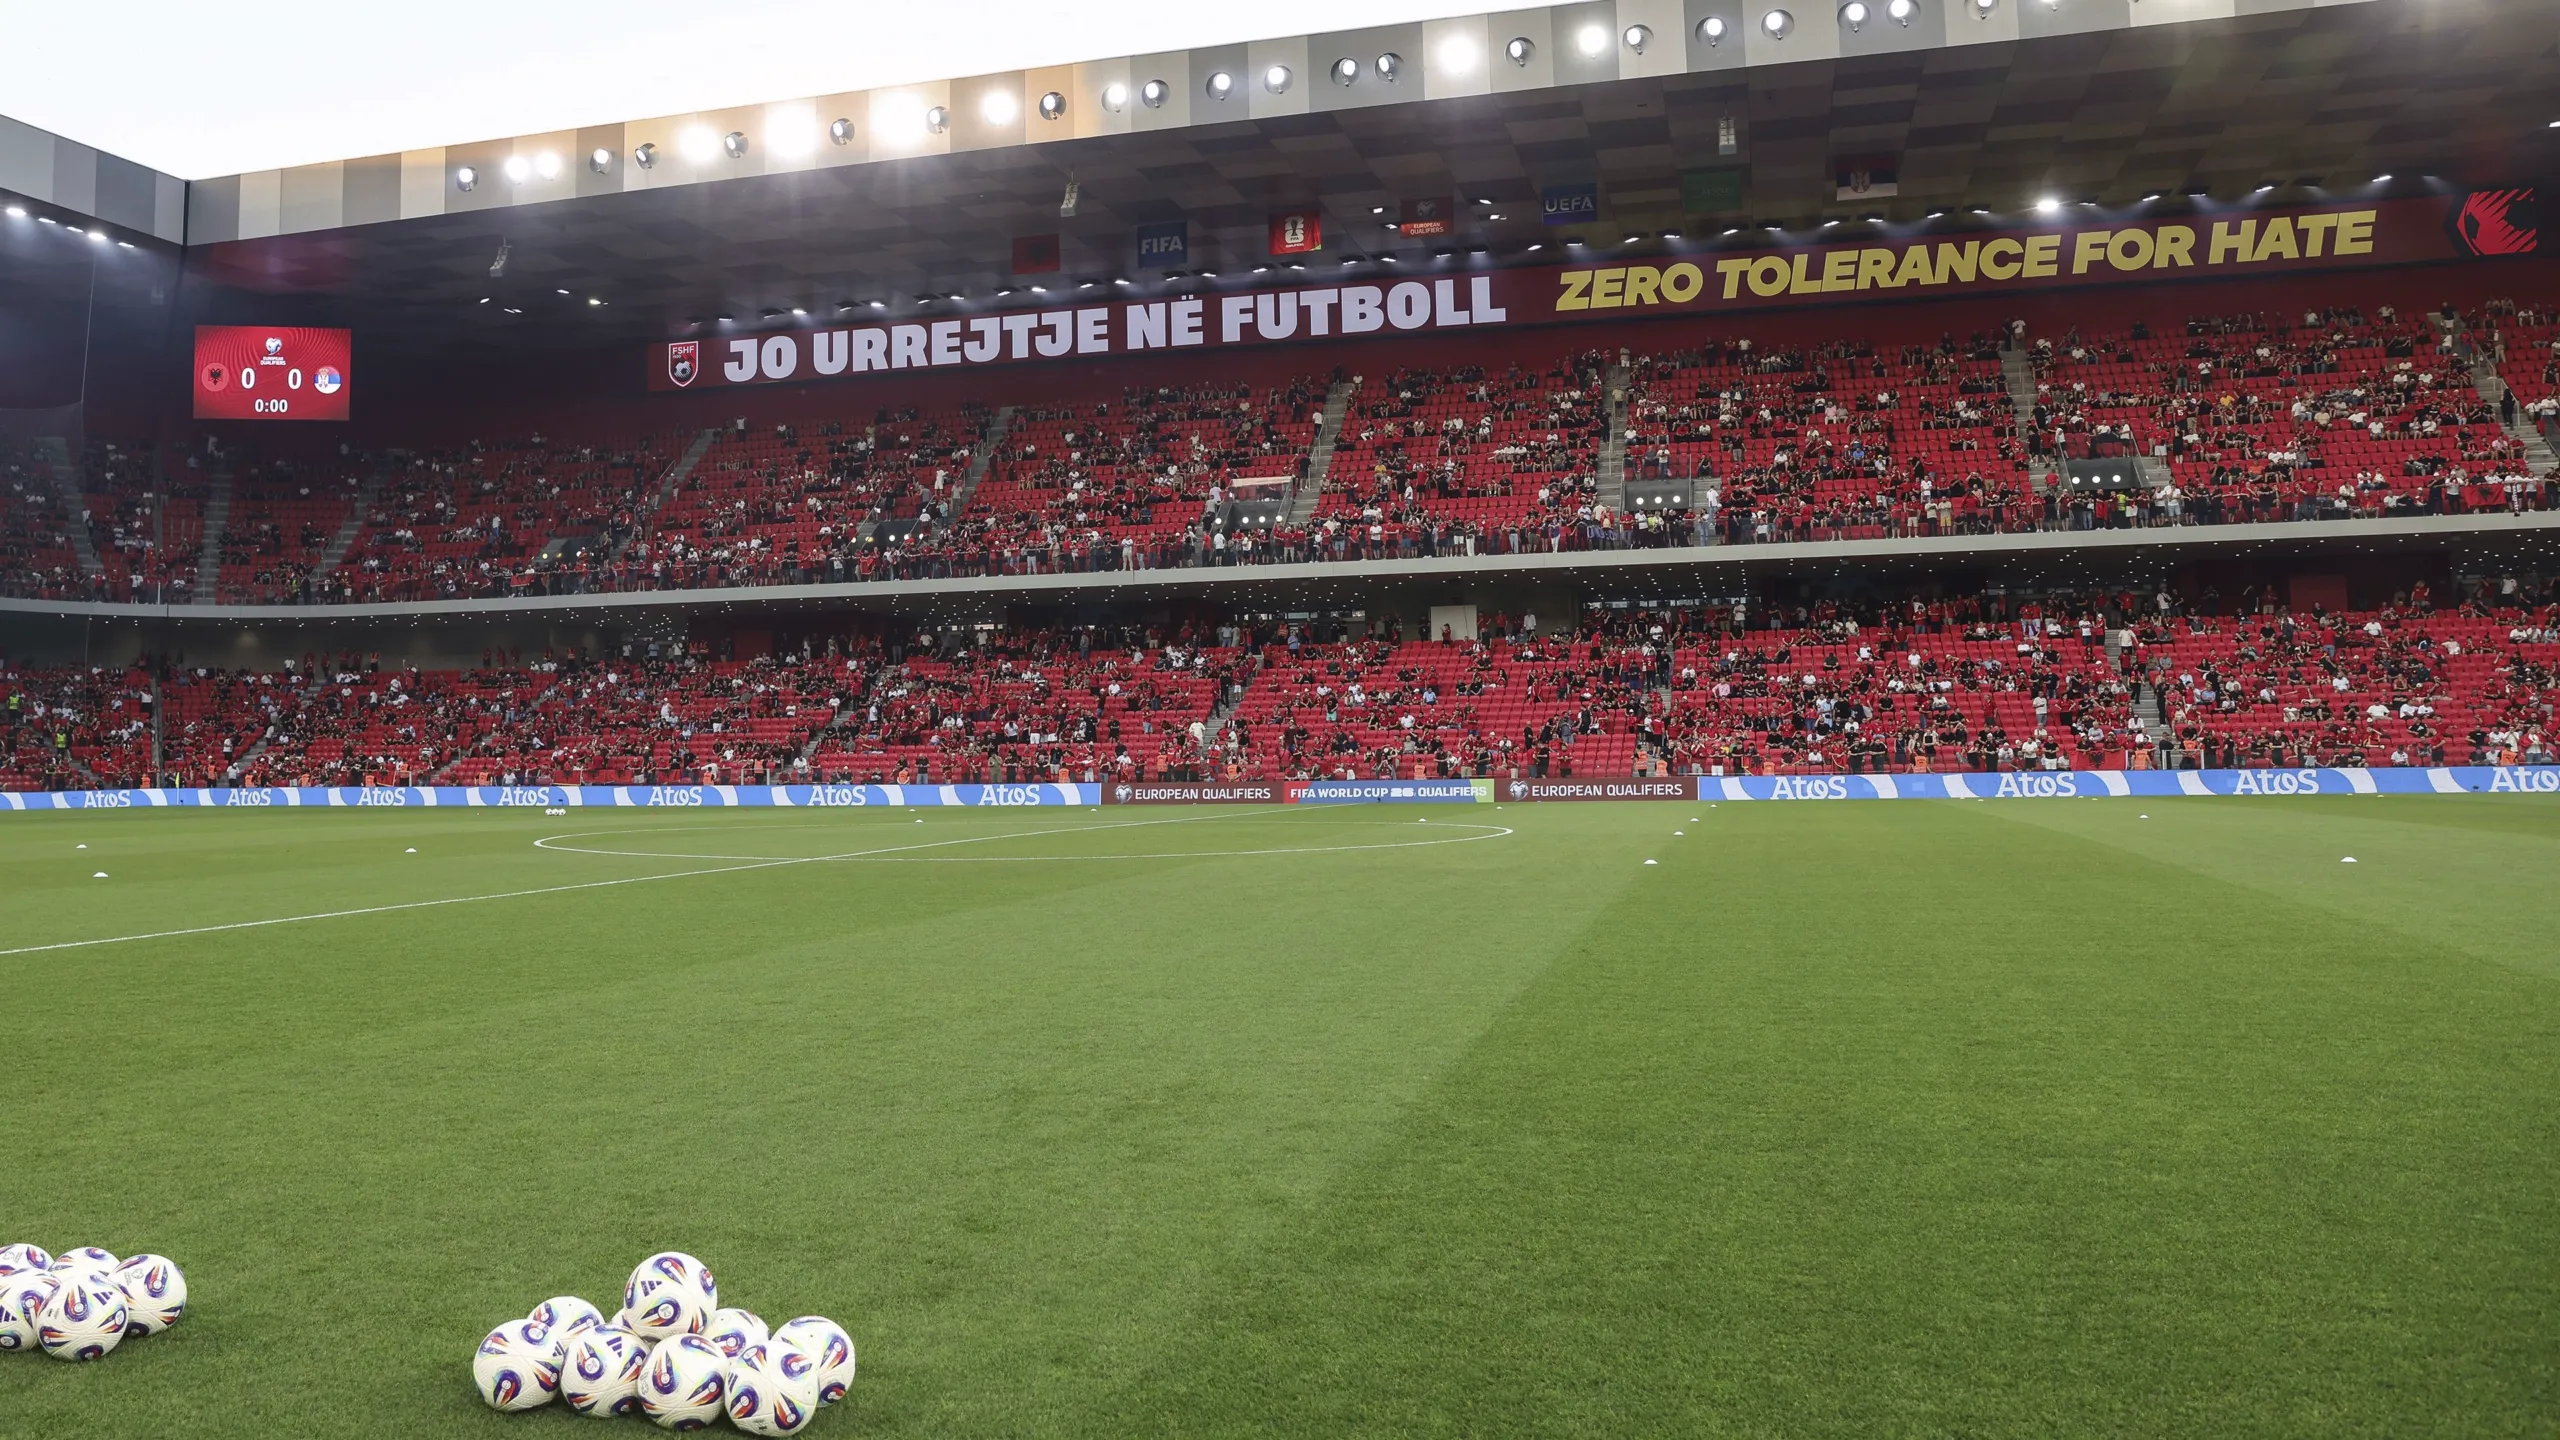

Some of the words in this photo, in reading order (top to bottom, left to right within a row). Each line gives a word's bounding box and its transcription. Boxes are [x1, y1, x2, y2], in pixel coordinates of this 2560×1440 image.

[1545, 196, 1594, 212] UEFA
[1410, 227, 1444, 235] QUALIFIERS
[1141, 235, 1183, 255] FIFA
[1555, 262, 1704, 311] ZERO
[1716, 234, 2062, 299] TOLERANCE
[2072, 224, 2196, 275] FOR
[2208, 209, 2377, 265] HATE
[724, 335, 797, 383] JO
[813, 307, 1109, 375] URREJTJE
[1126, 294, 1204, 350] NË
[1222, 276, 1506, 343] FUTBOLL
[672, 345, 695, 355] FSHF
[241, 367, 256, 389] 0
[287, 368, 302, 390] 0
[254, 398, 289, 413] 0:00
[2488, 767, 2560, 793] Ato
[1135, 788, 1199, 800] EUROPEAN
[1202, 788, 1271, 800] QUALIFIERS
[1290, 788, 1316, 798] FIFA
[1318, 787, 1362, 798] WORLD
[1363, 787, 1388, 798] CUP
[1390, 787, 1414, 798] 26
[1417, 786, 1487, 798] QUALIFIERS
[1532, 784, 1603, 797] EUROPEAN
[1606, 783, 1683, 796] QUALIFIERS
